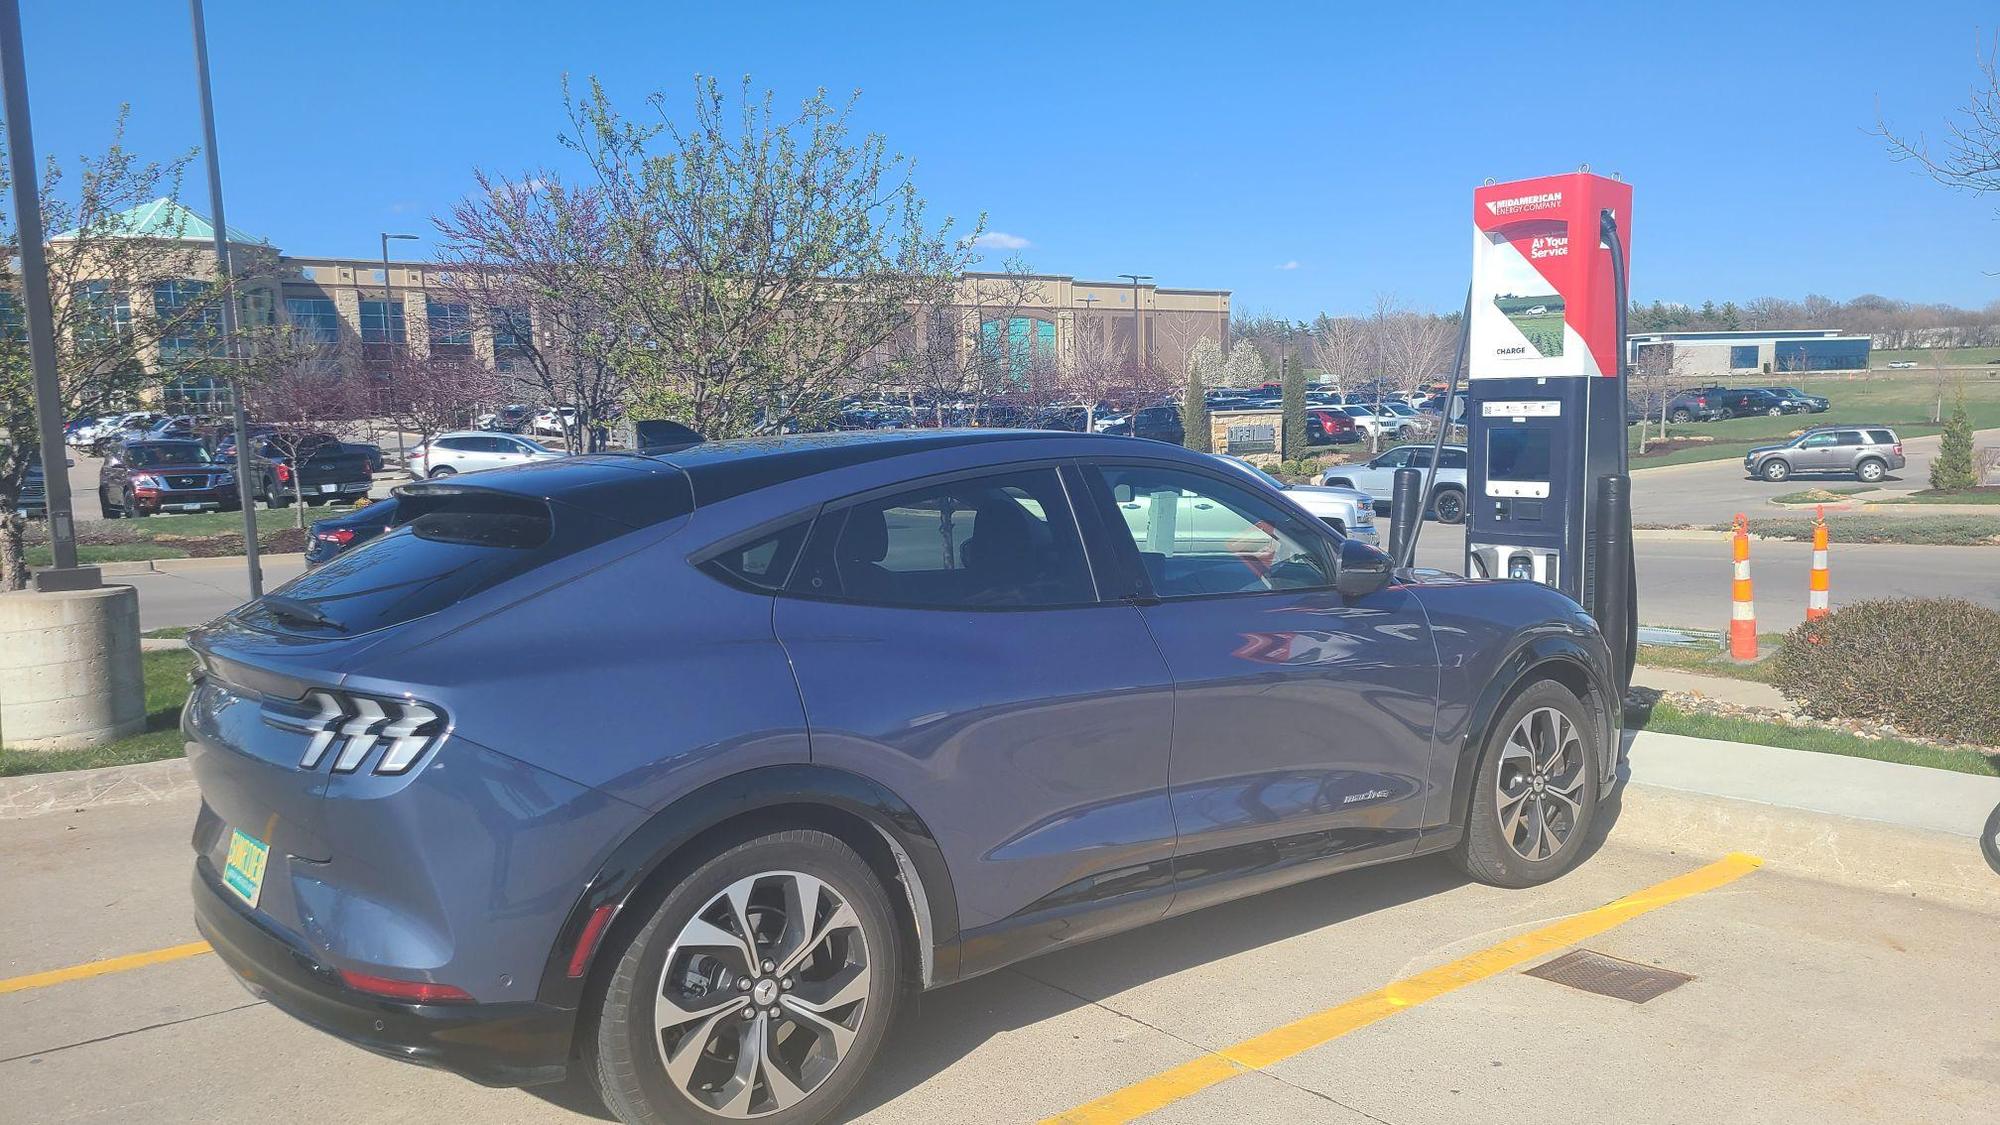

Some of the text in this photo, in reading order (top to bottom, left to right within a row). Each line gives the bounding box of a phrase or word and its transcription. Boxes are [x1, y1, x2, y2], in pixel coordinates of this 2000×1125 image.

[1497, 192, 1562, 208] MIDAMERICAN
[1497, 200, 1562, 216] ENERGY COMPANY
[1532, 238, 1544, 249] At
[1531, 247, 1568, 259] Service
[1496, 347, 1526, 355] CHARGE
